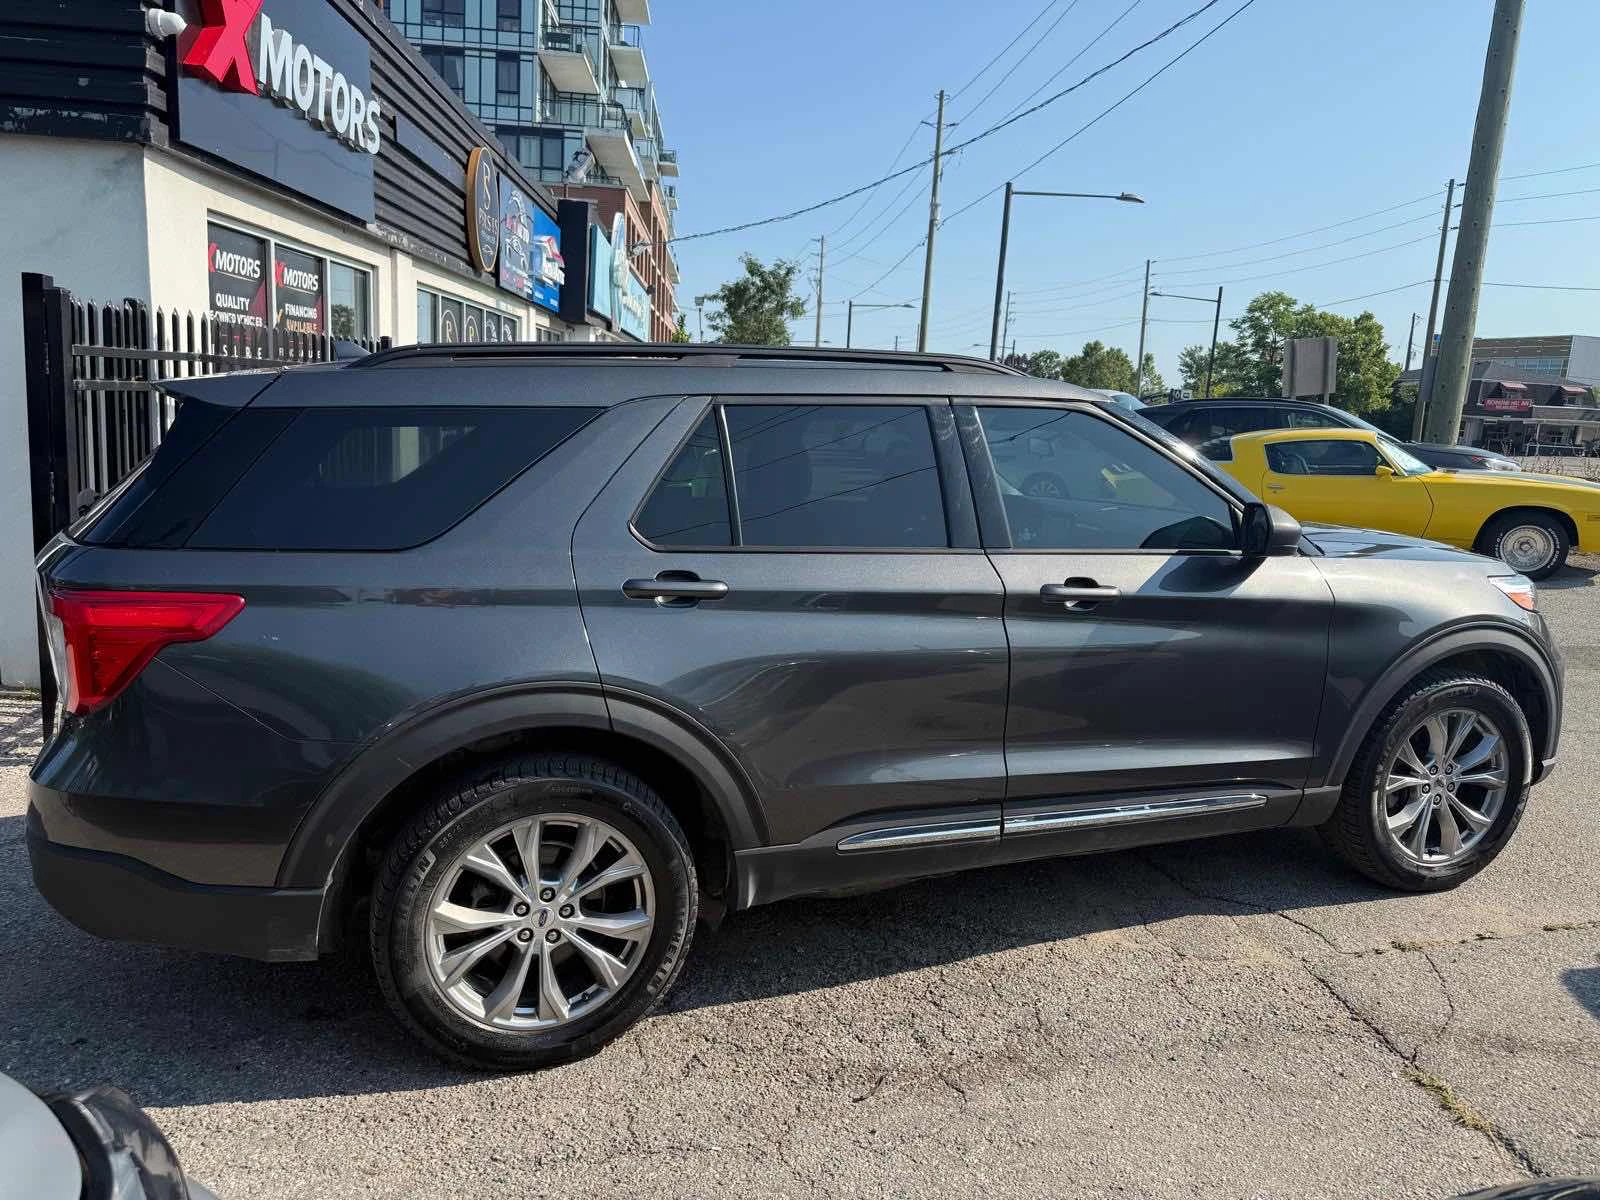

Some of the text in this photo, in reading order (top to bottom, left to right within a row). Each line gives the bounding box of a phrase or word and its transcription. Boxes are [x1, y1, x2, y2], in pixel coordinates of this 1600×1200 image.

[259, 13, 382, 155] MOTORS
[215, 249, 261, 279] MOTORS
[283, 267, 319, 291] MOTORS
[215, 293, 250, 311] QUALITY
[285, 303, 318, 319] FINANCING
